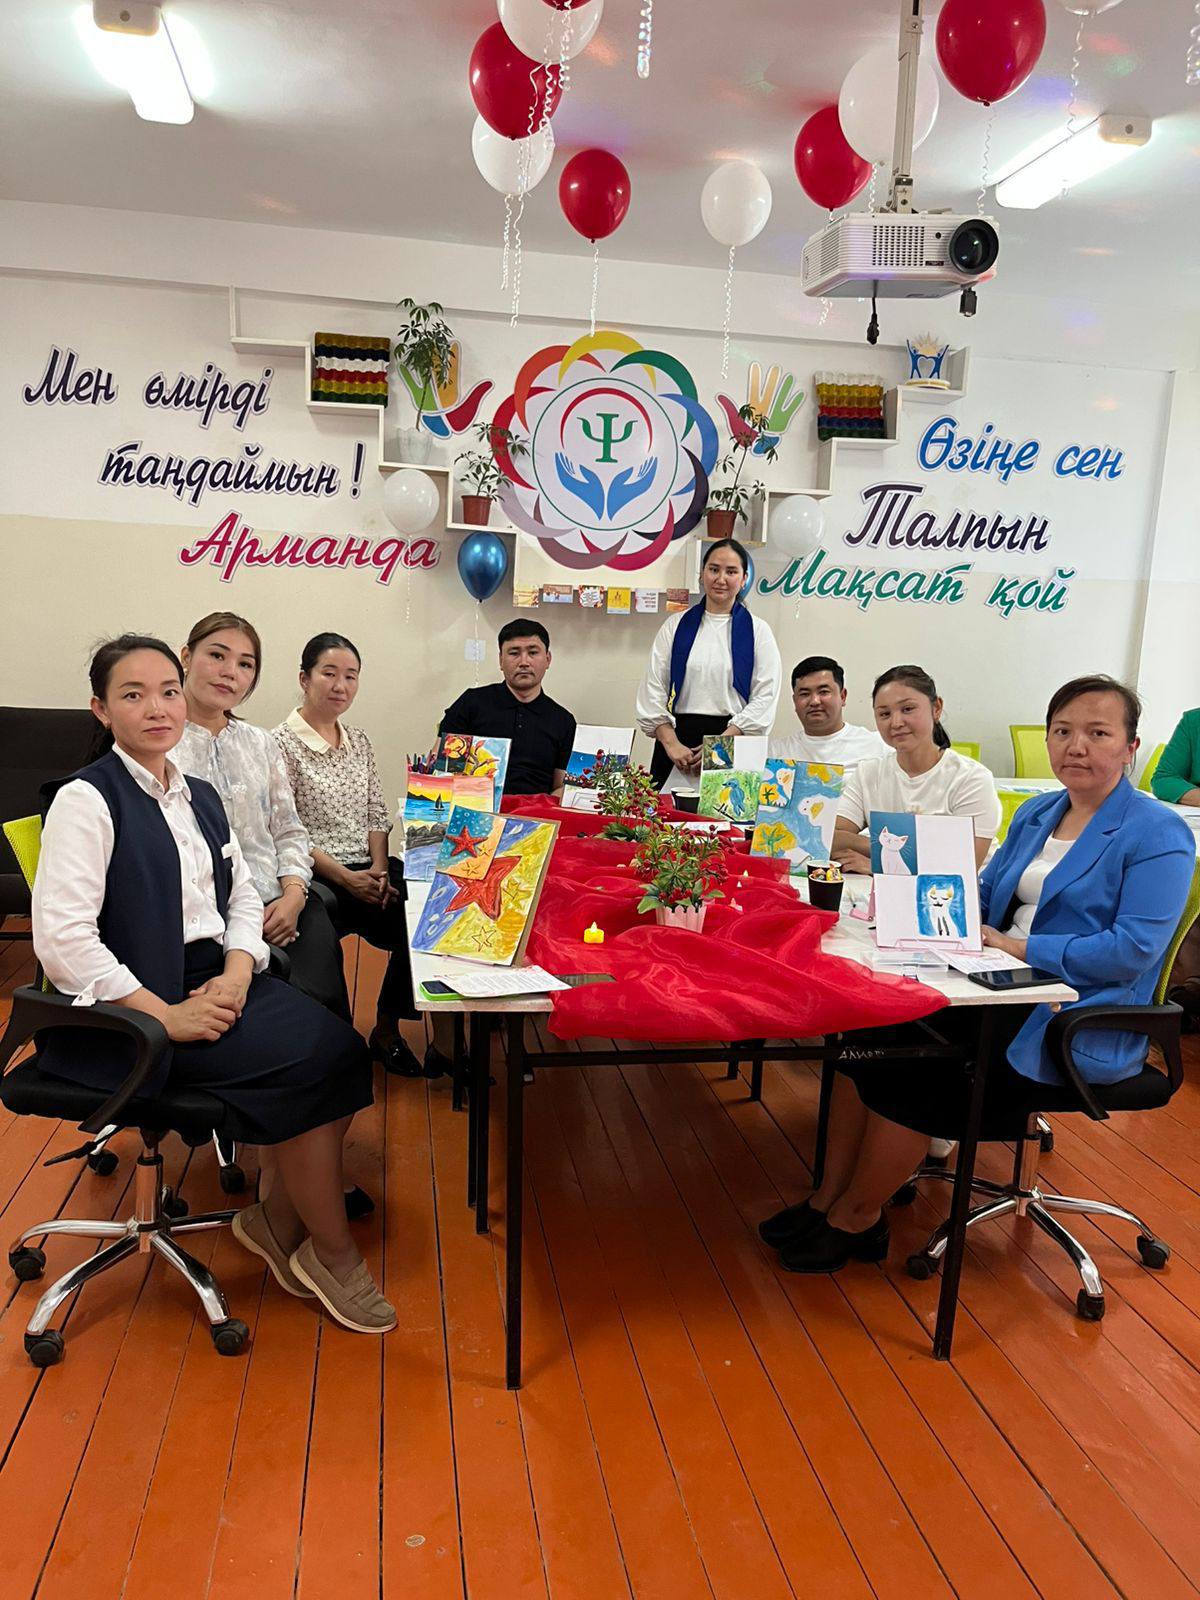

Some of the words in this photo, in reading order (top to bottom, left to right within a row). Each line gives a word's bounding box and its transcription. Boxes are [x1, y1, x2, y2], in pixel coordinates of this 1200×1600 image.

[23, 346, 117, 405] Мен
[144, 363, 273, 428] өмірді
[99, 442, 338, 505] таңдаймын
[918, 416, 1041, 483] Өзіңе
[1054, 445, 1125, 482] сен
[179, 512, 437, 583] Арманда
[844, 483, 1050, 551] Талпын
[760, 549, 972, 609] Мақсат
[986, 568, 1075, 617] қой
